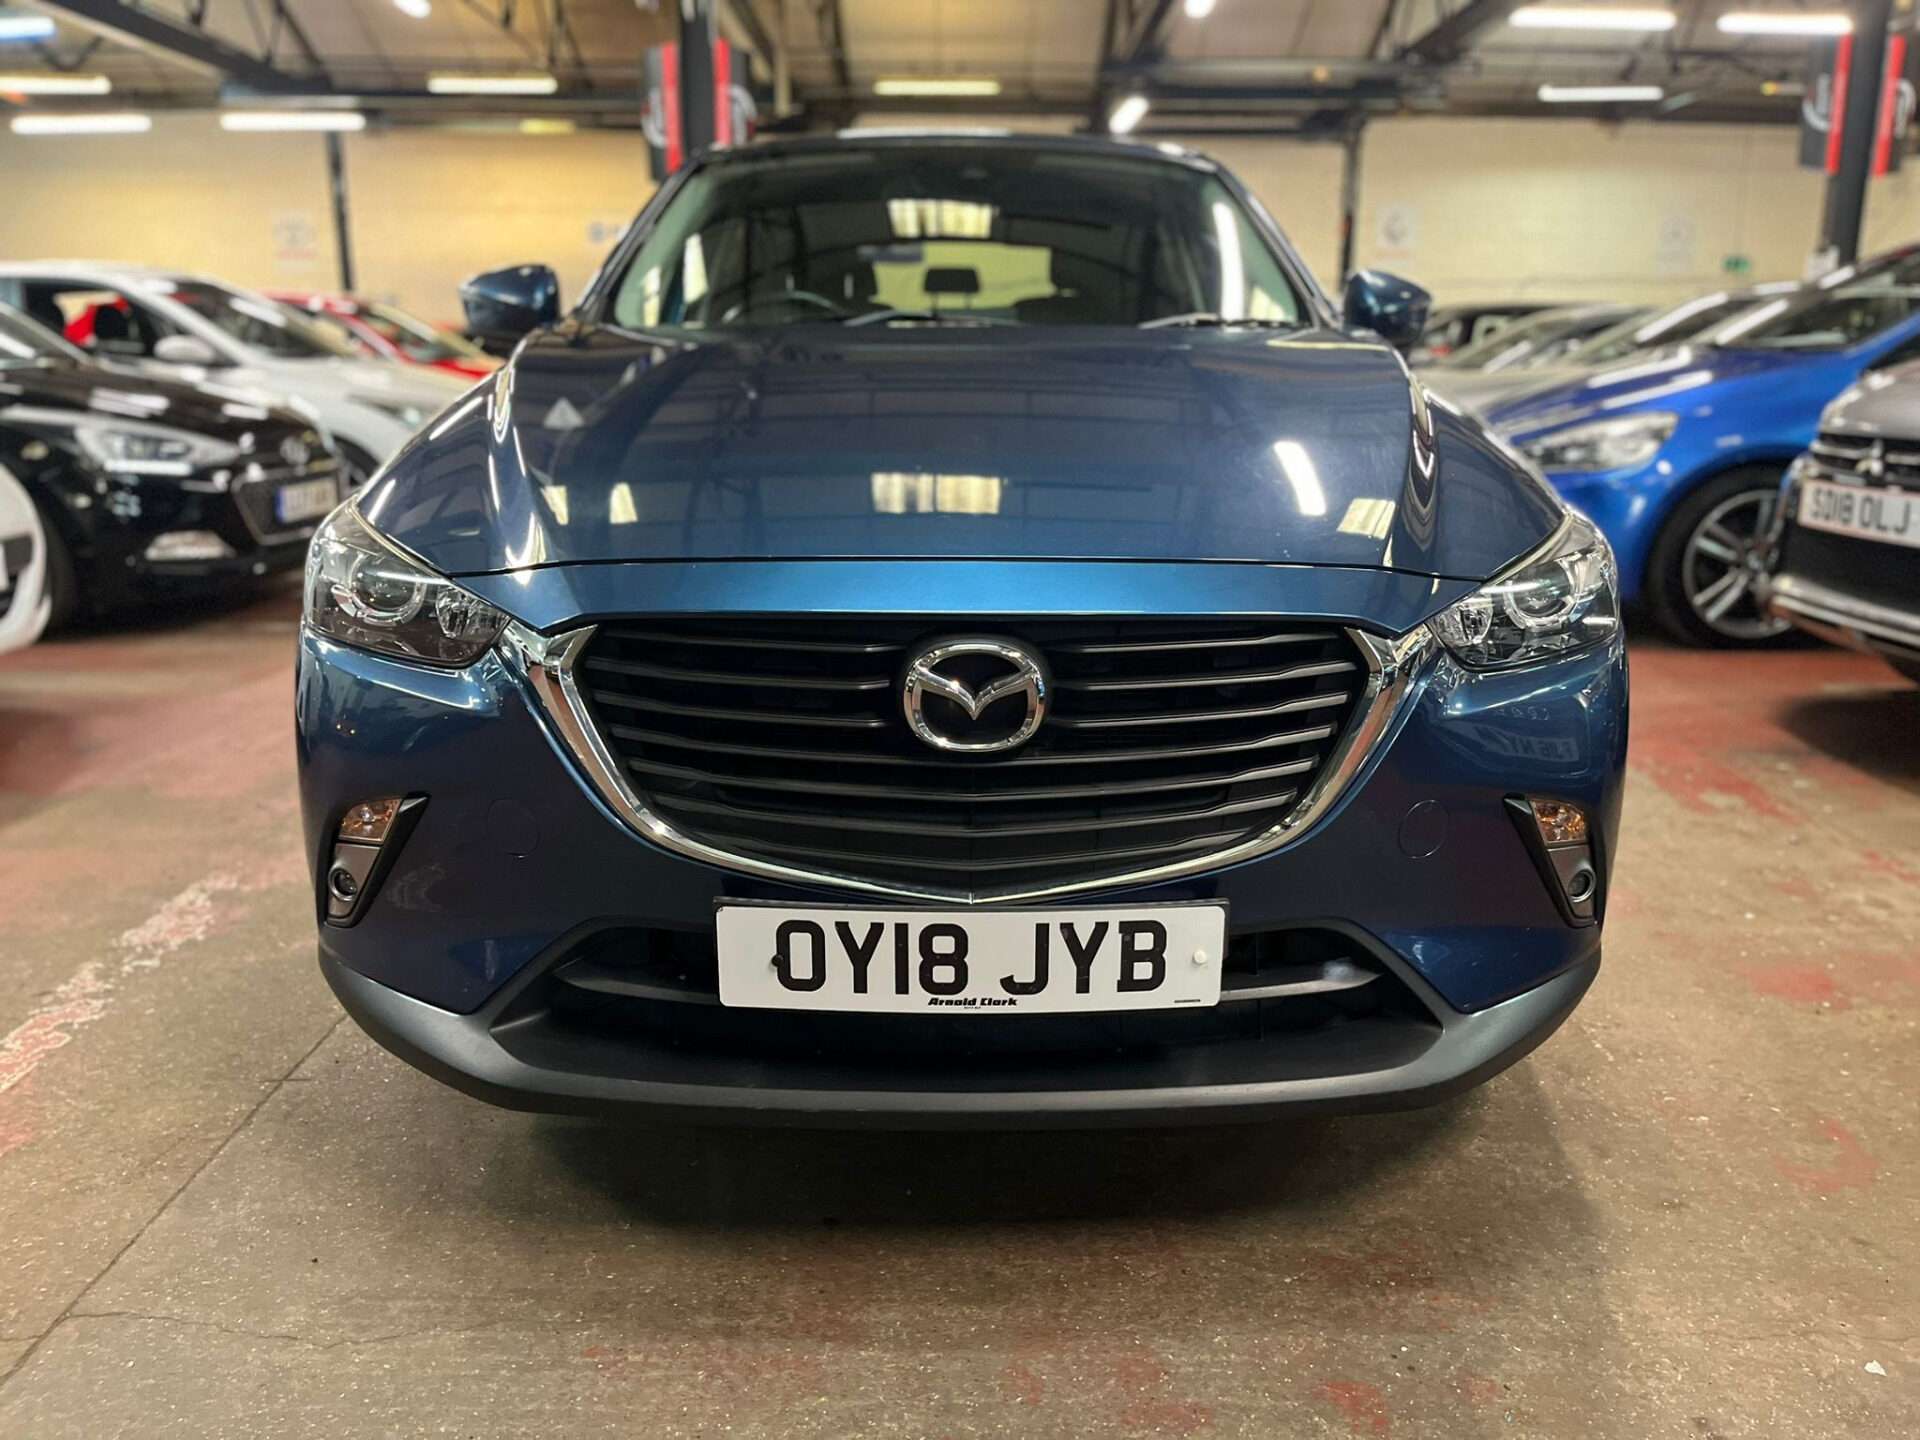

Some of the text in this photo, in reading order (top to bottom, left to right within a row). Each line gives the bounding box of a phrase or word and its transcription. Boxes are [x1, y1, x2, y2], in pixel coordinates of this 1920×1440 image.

[1860, 495, 1912, 535] OLJ
[775, 919, 1168, 995] OY18 JYB
[927, 997, 1018, 1006] Arnold Clark
